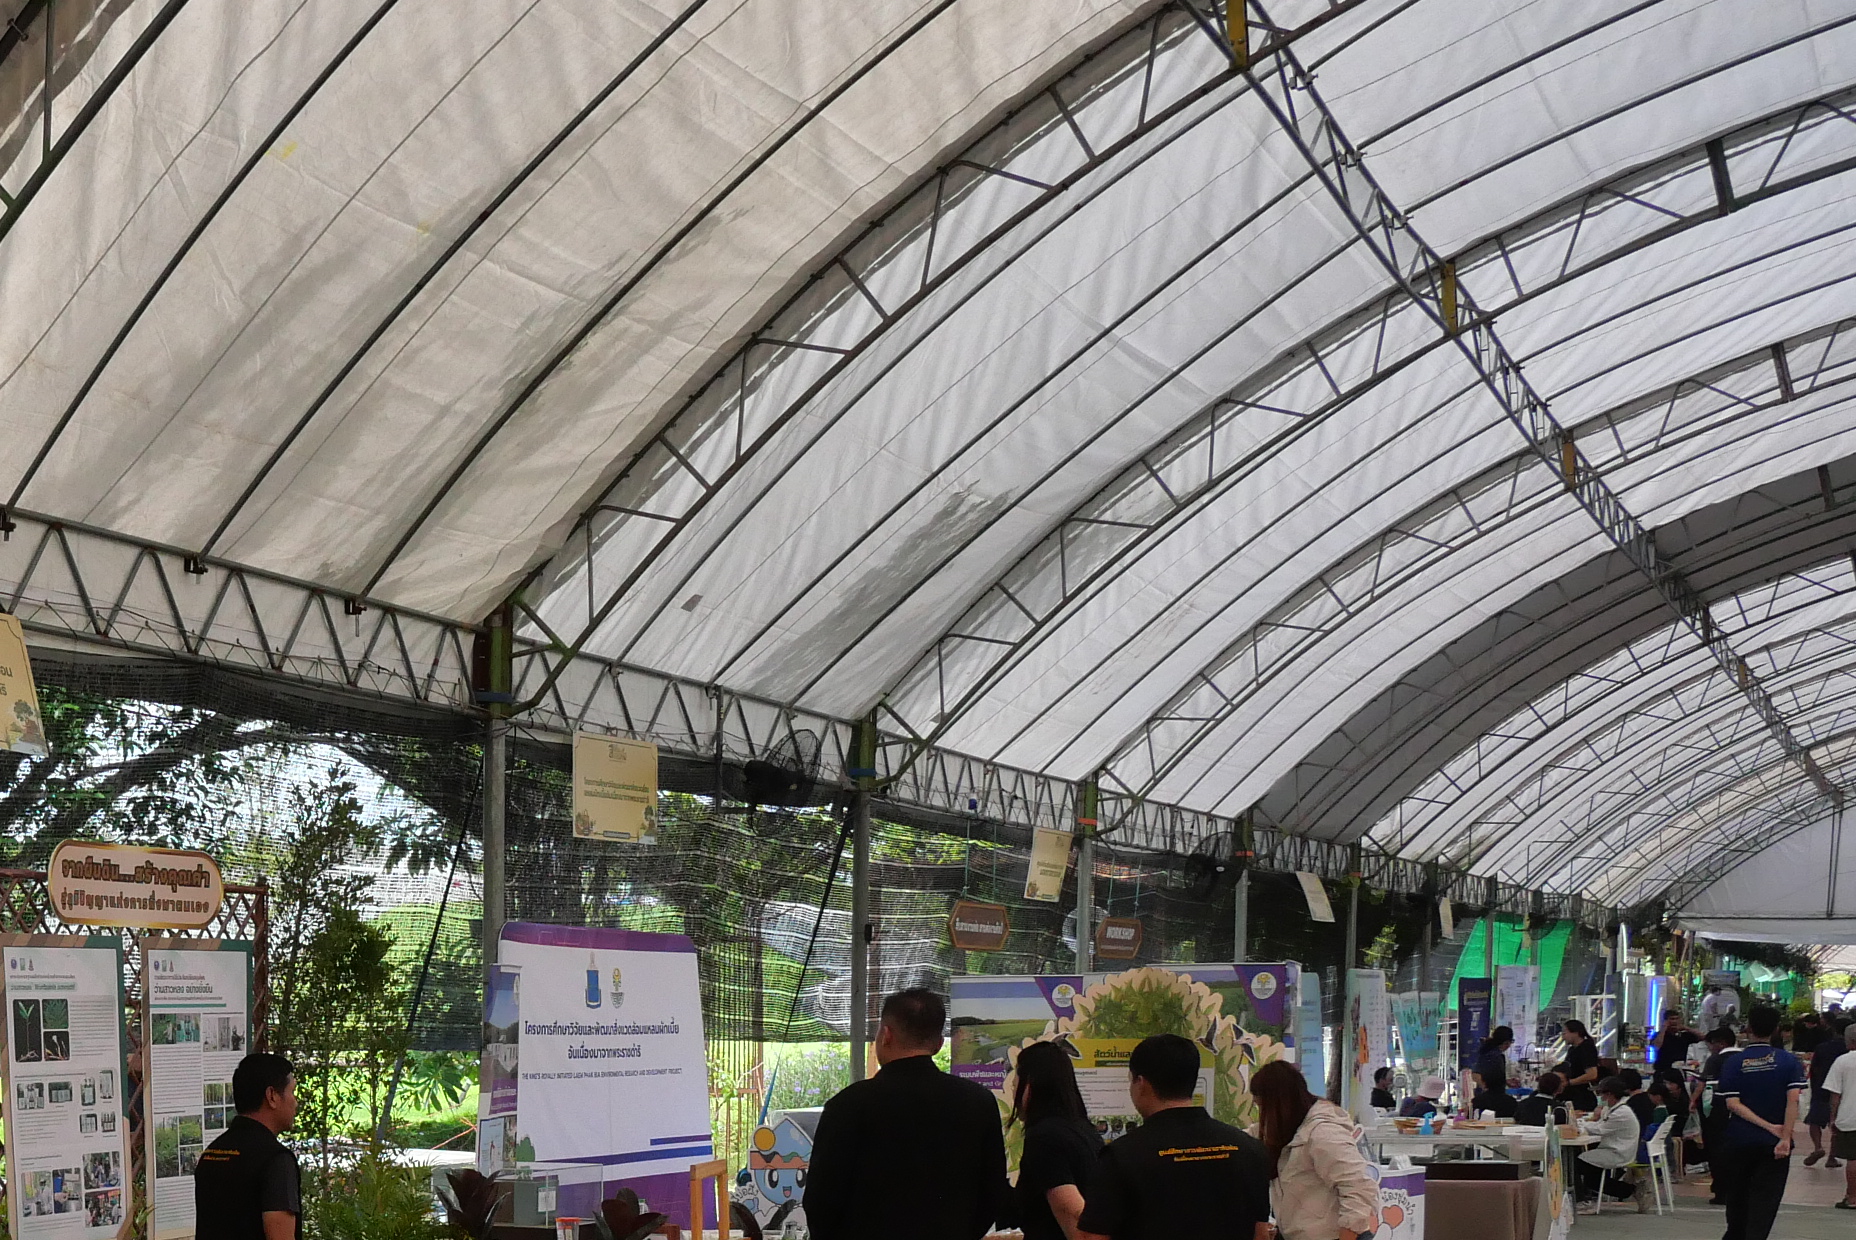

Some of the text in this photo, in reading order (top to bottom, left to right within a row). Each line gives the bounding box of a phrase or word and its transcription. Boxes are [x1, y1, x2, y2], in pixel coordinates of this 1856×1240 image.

[524, 1017, 679, 1036] โครงการศึกษาวิจัยและพัฒนาสิ่งแวดล้อมแหลมผักเบี้ย
[568, 1041, 642, 1059] อันเนื่องมาจากพระราชดำริ
[1094, 1046, 1132, 1058] สัตว์น้ำแล
